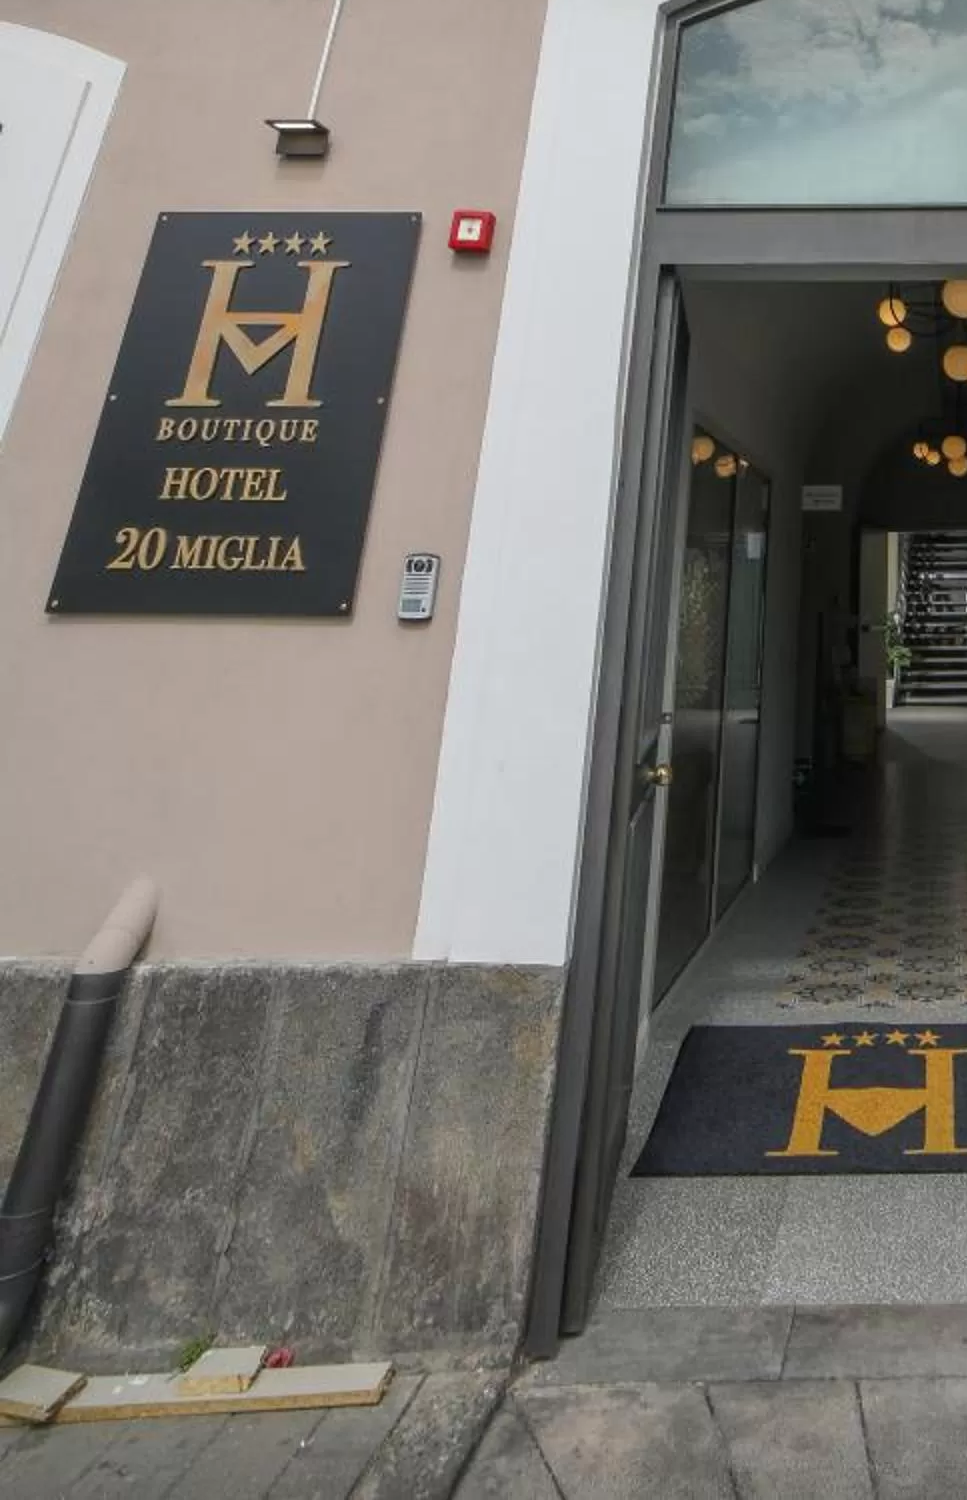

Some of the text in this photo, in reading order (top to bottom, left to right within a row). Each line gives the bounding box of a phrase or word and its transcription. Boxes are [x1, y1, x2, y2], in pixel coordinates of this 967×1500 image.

[156, 418, 319, 447] BOUTIQUE
[158, 466, 287, 502] HOTEL
[105, 527, 307, 572] 20 MIGLIA
